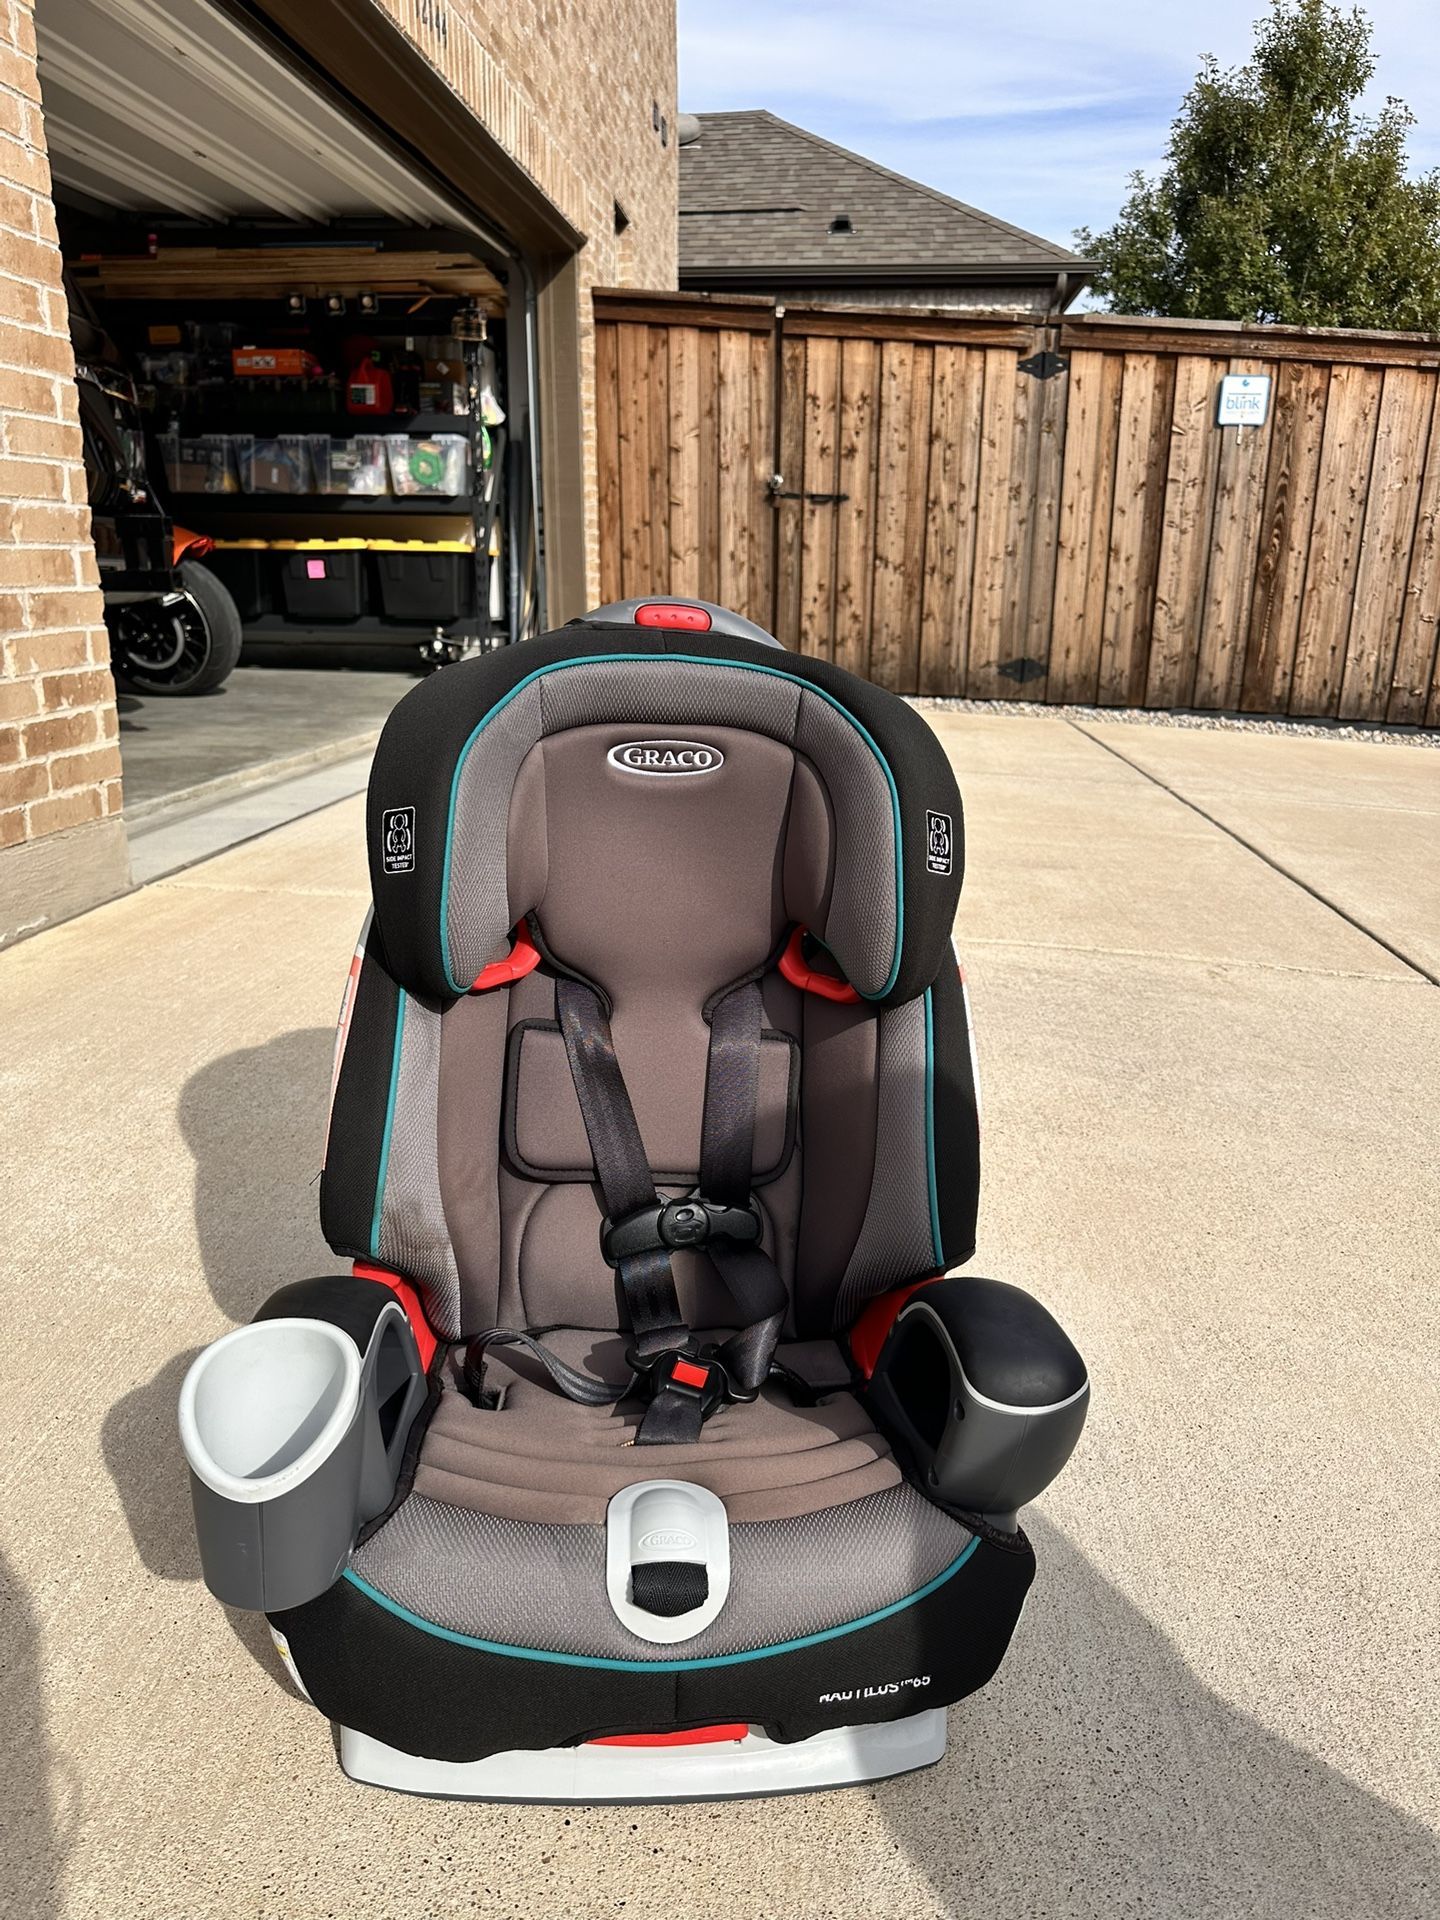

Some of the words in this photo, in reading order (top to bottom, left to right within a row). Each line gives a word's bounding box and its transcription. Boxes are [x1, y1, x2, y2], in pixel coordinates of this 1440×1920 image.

[1226, 396, 1260, 410] blink
[623, 748, 713, 767] GRACO
[386, 855, 396, 863] SIDE
[397, 853, 413, 861] IMPACT
[649, 1534, 693, 1547] GRACO
